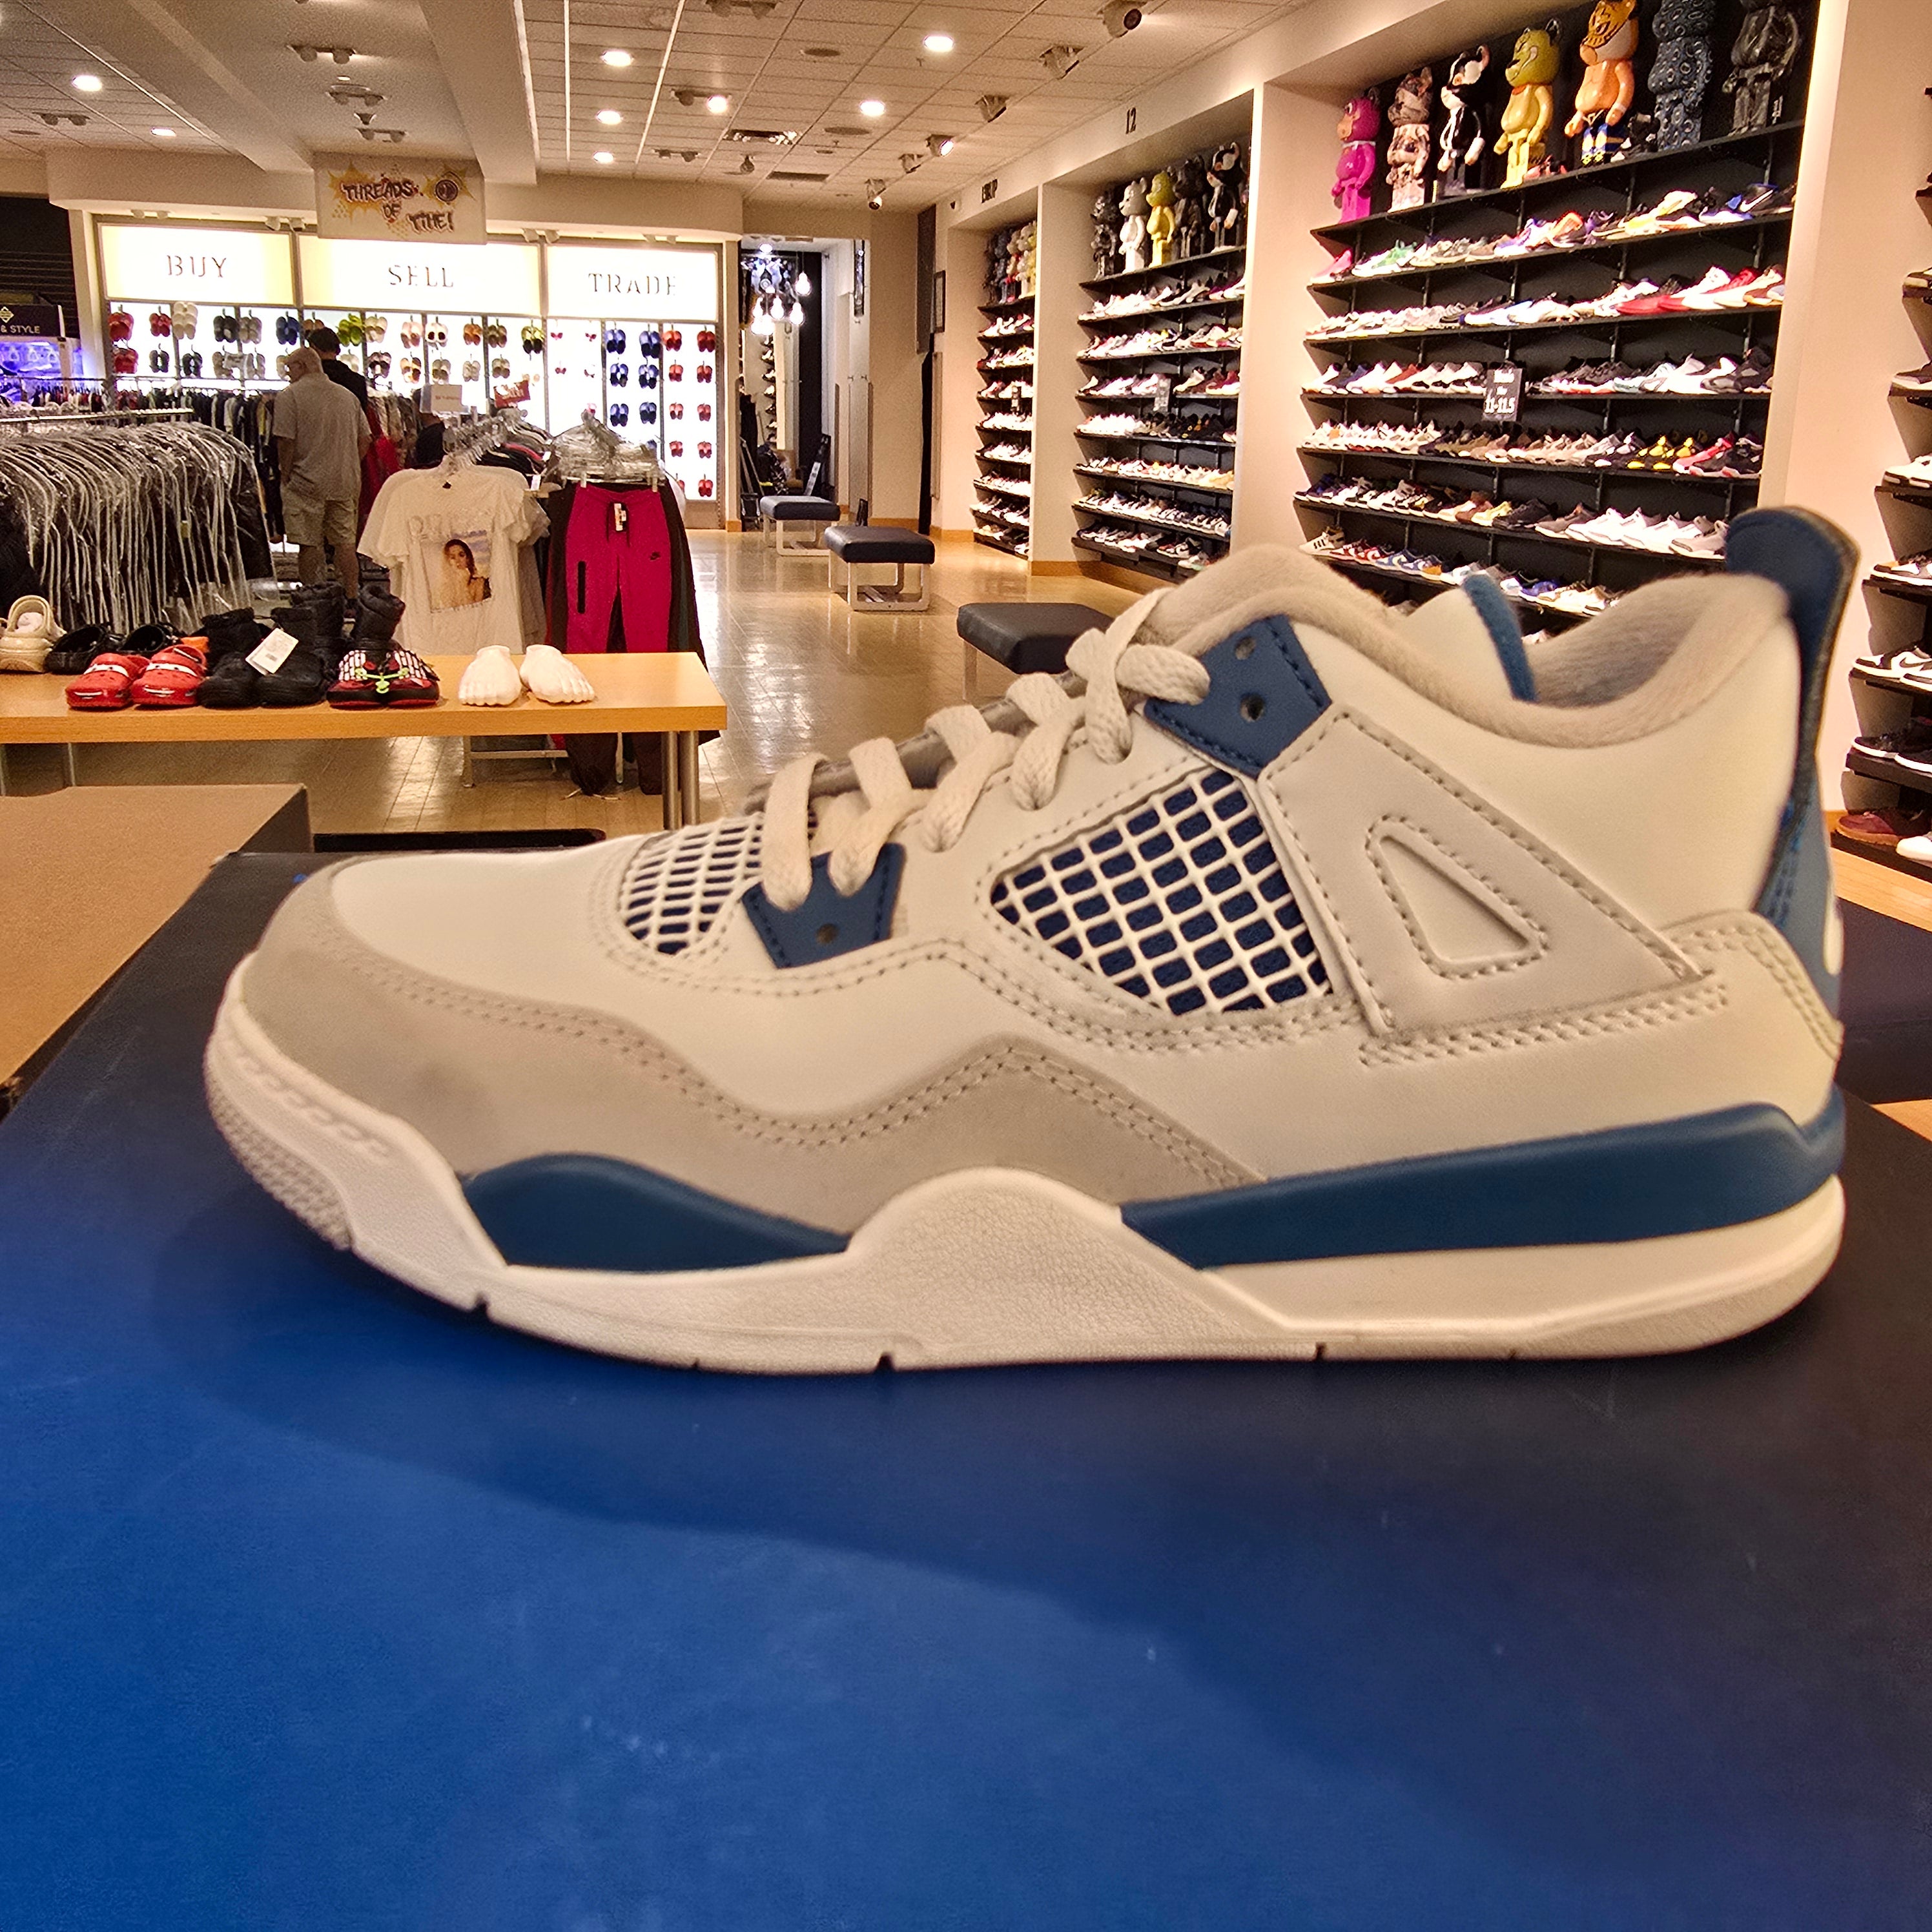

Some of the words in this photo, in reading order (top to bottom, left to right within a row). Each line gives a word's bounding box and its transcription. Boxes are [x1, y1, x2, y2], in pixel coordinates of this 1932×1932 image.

[1125, 107, 1136, 134] 12
[342, 179, 416, 203] THREADS
[167, 254, 227, 278] BUY
[388, 264, 454, 287] SELL
[588, 272, 675, 296] TRADE
[10, 325, 40, 334] STYLE
